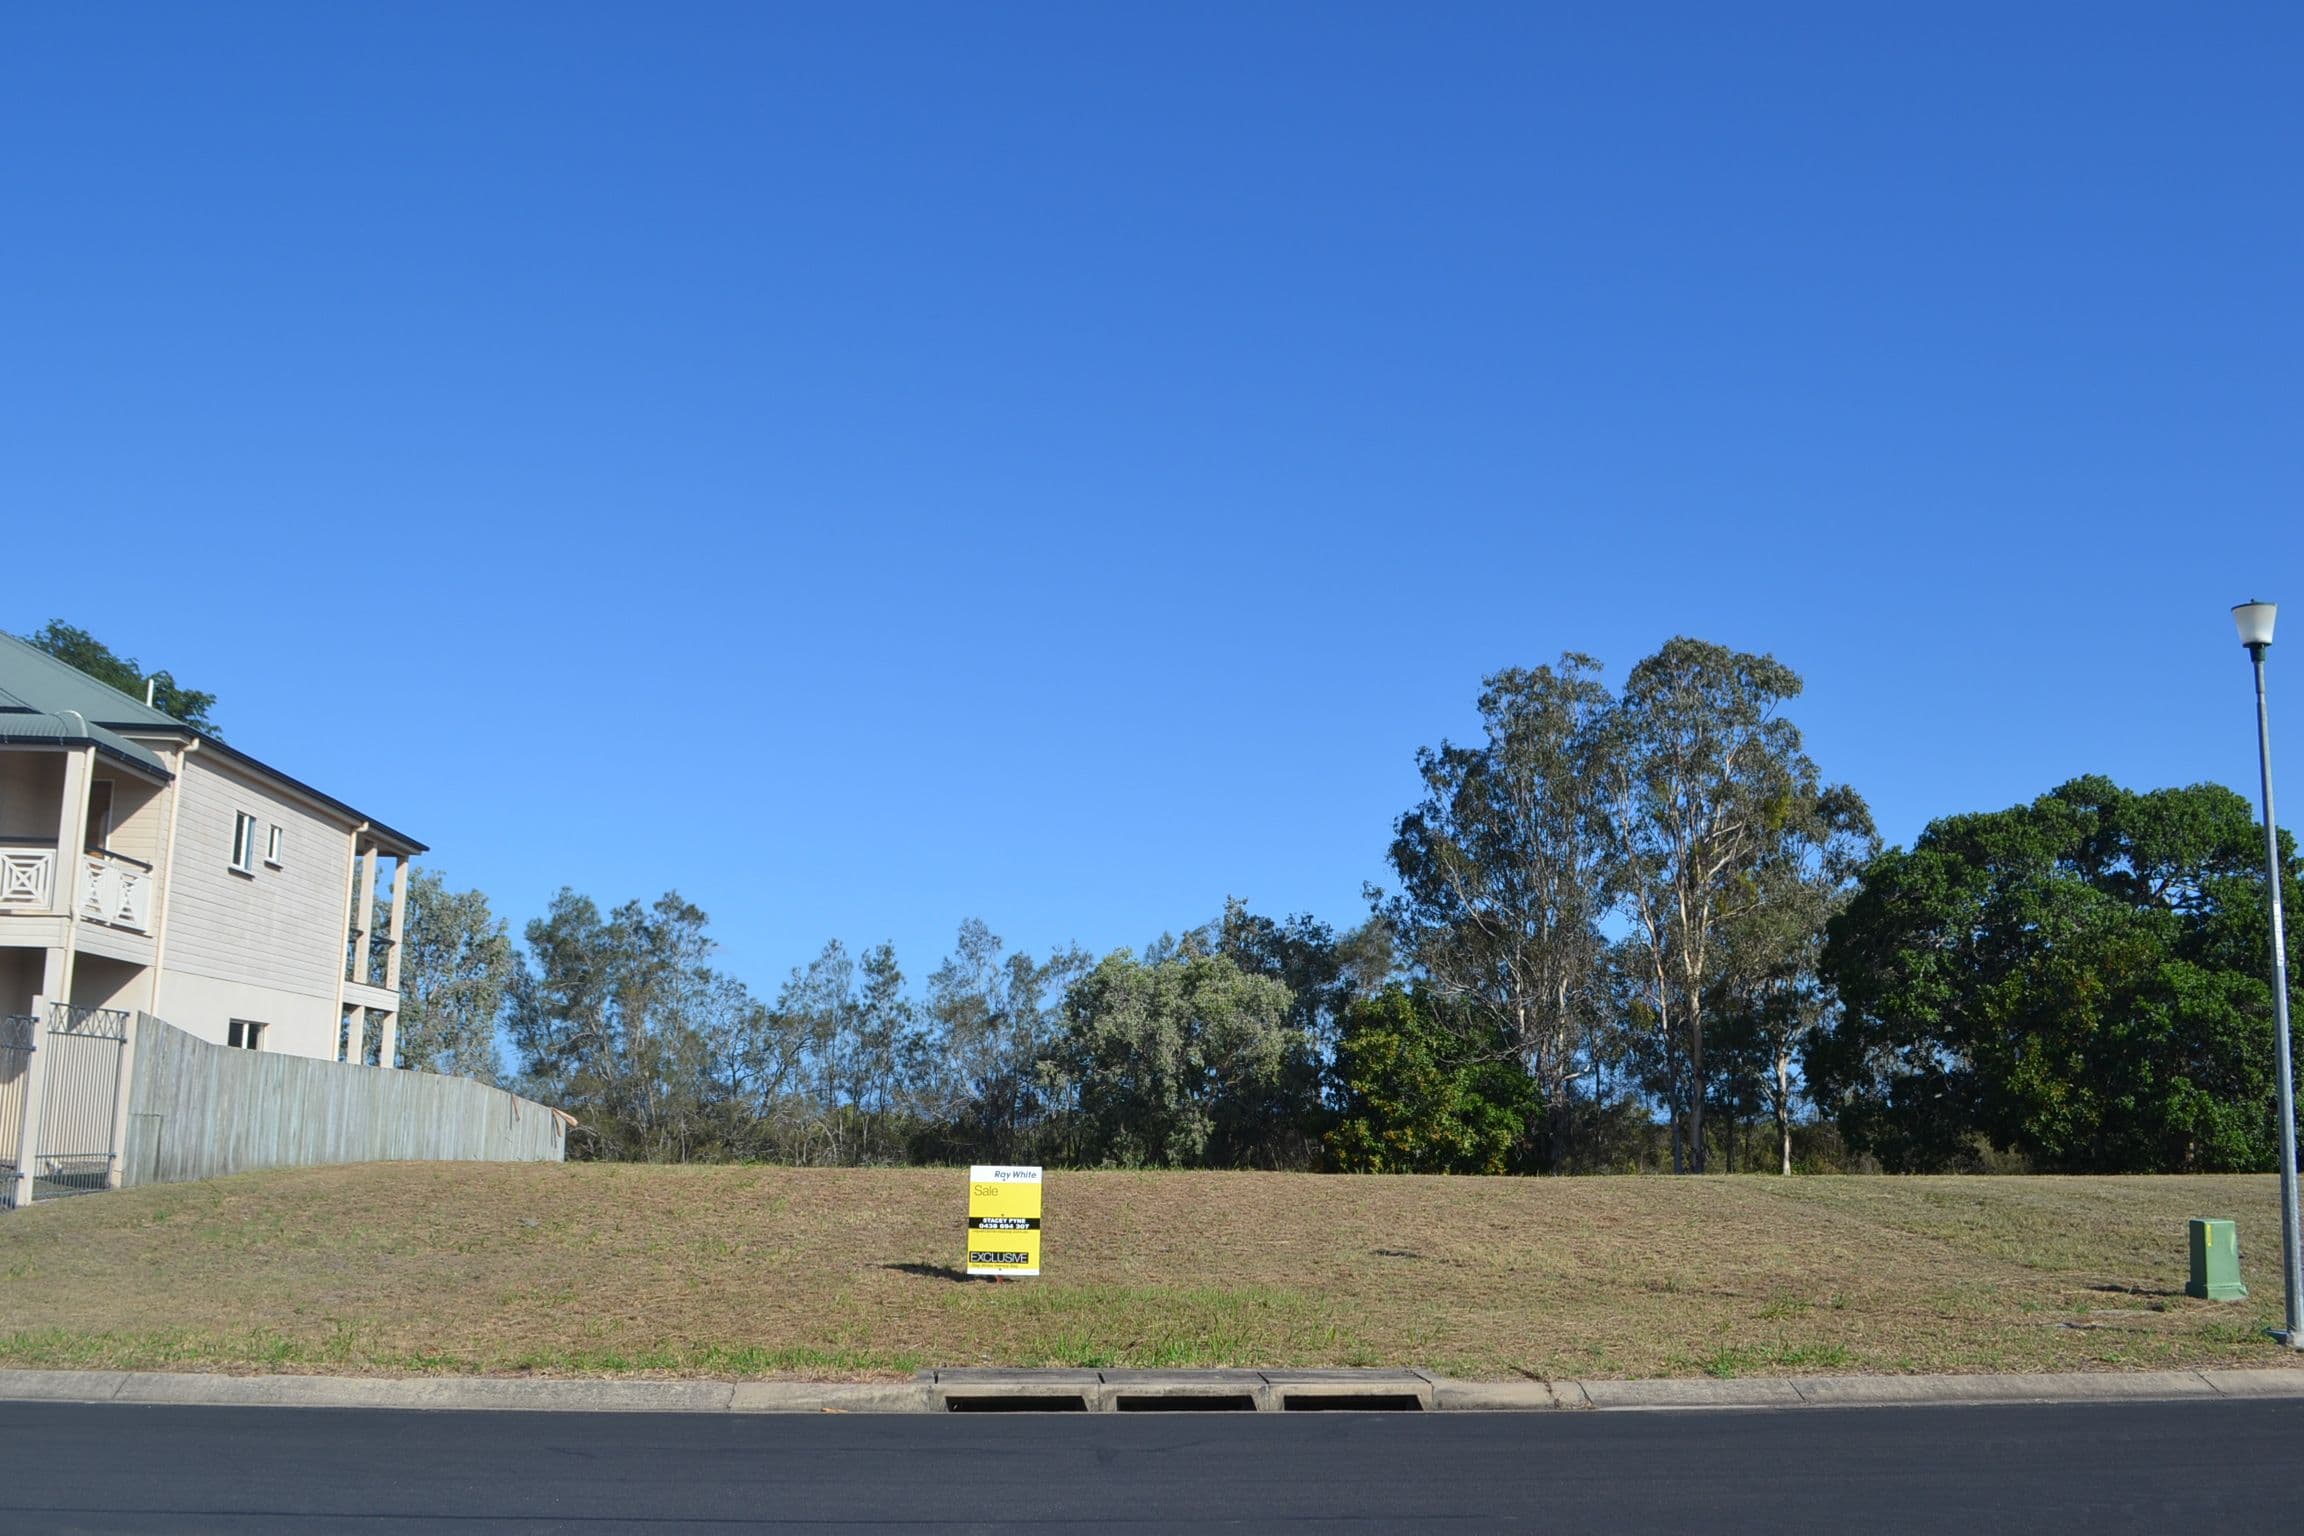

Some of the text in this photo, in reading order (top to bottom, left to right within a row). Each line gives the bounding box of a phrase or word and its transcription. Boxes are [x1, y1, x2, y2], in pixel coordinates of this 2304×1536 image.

[994, 1170, 1037, 1179] Ray White
[974, 1184, 999, 1197] Sale
[970, 1252, 1028, 1263] EXCLUSIVE
